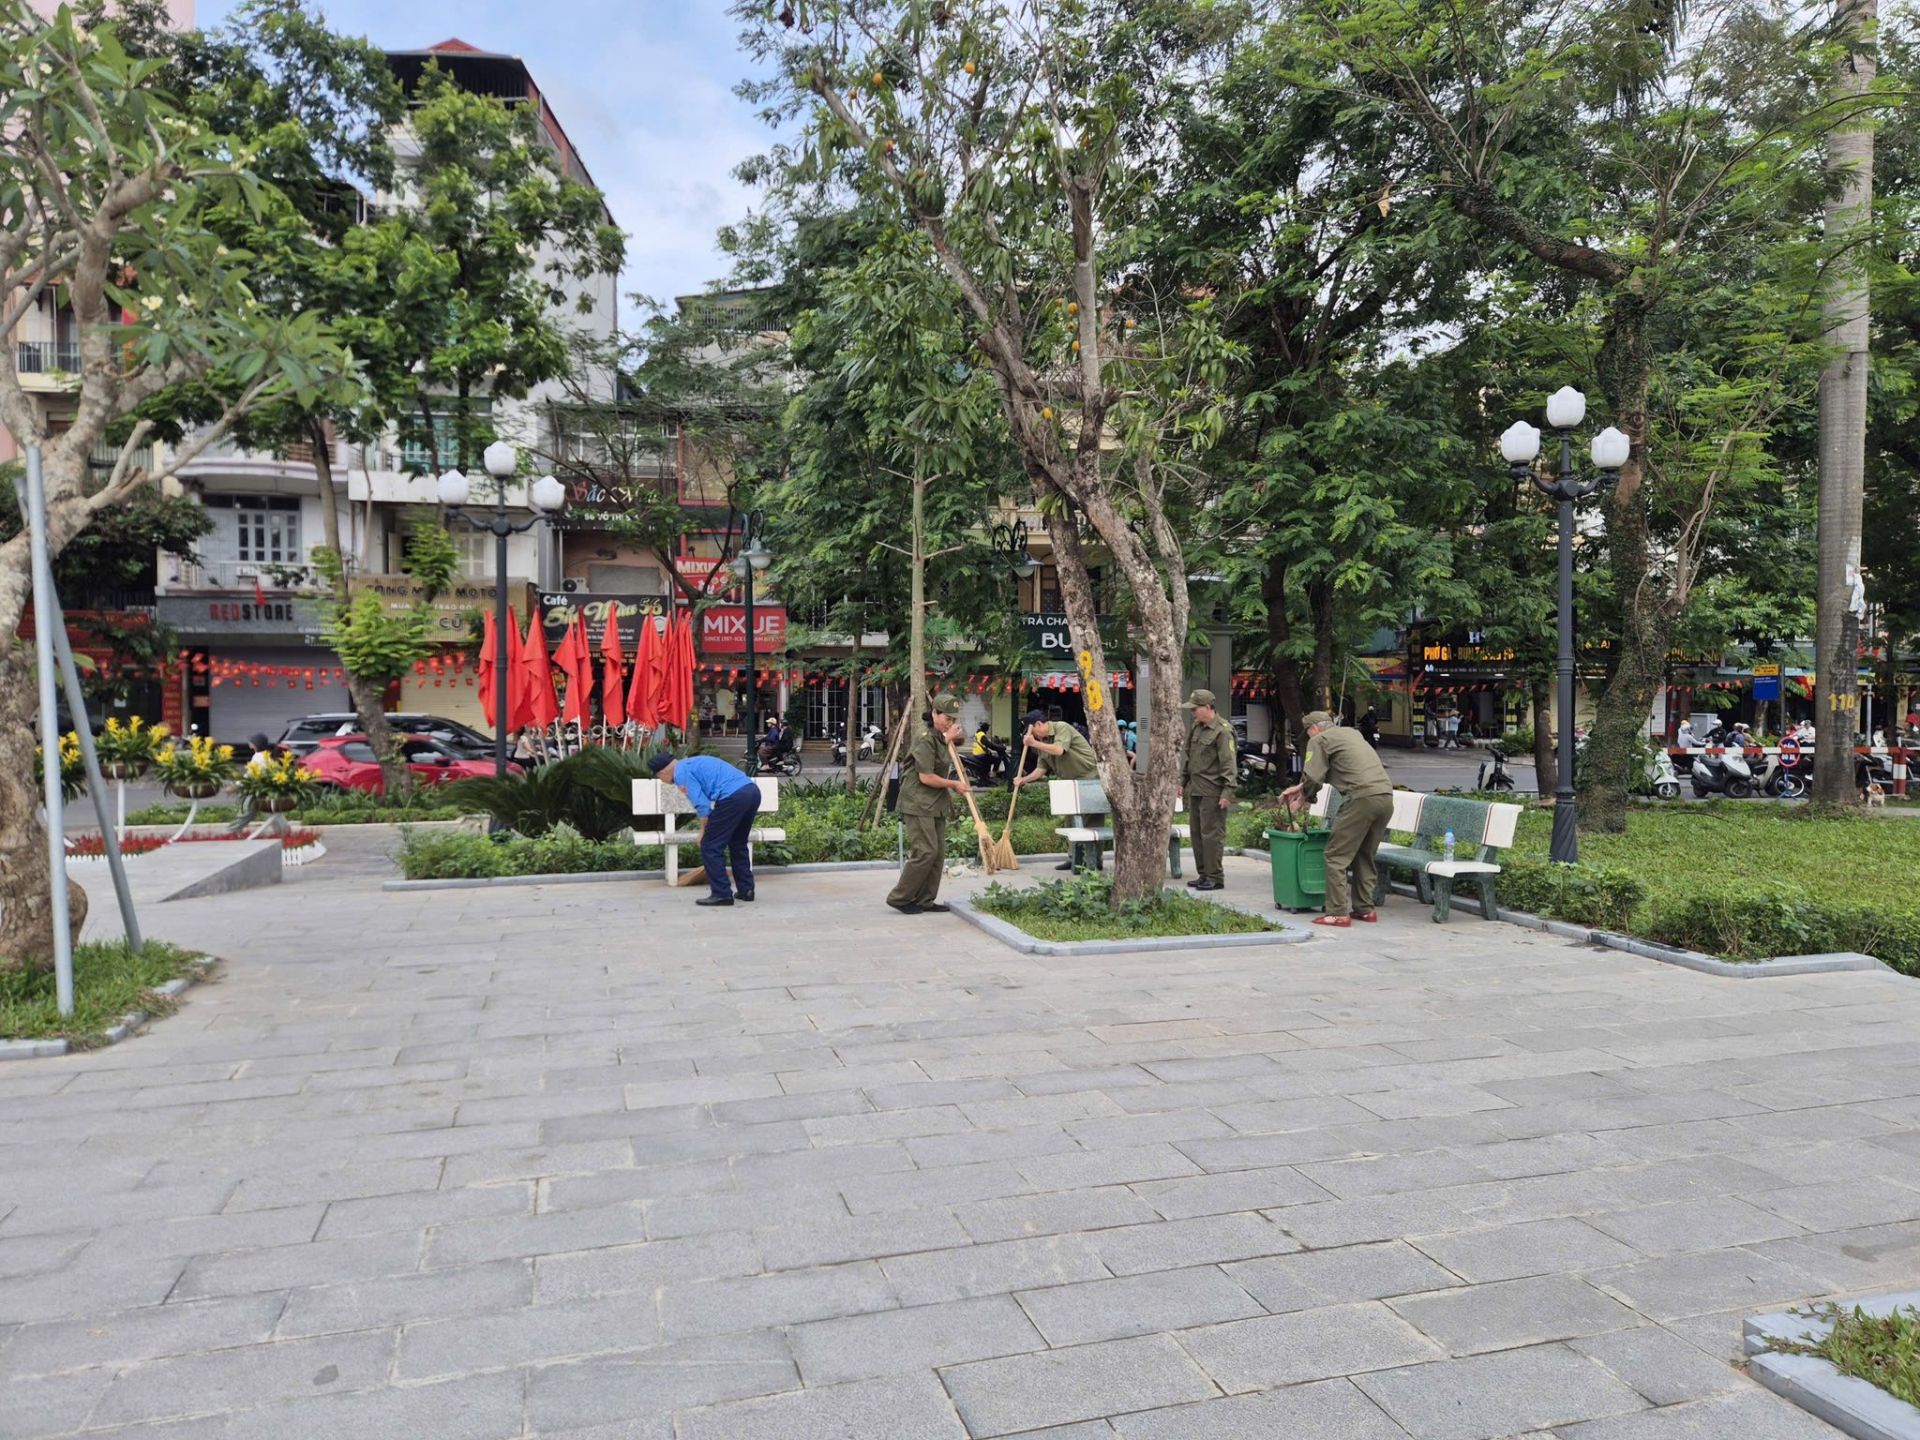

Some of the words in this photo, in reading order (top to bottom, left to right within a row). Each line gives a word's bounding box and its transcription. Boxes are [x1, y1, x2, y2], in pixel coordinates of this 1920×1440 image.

[543, 595, 568, 606] Café
[1046, 617, 1069, 626] CHA
[1828, 693, 1856, 712] 110
